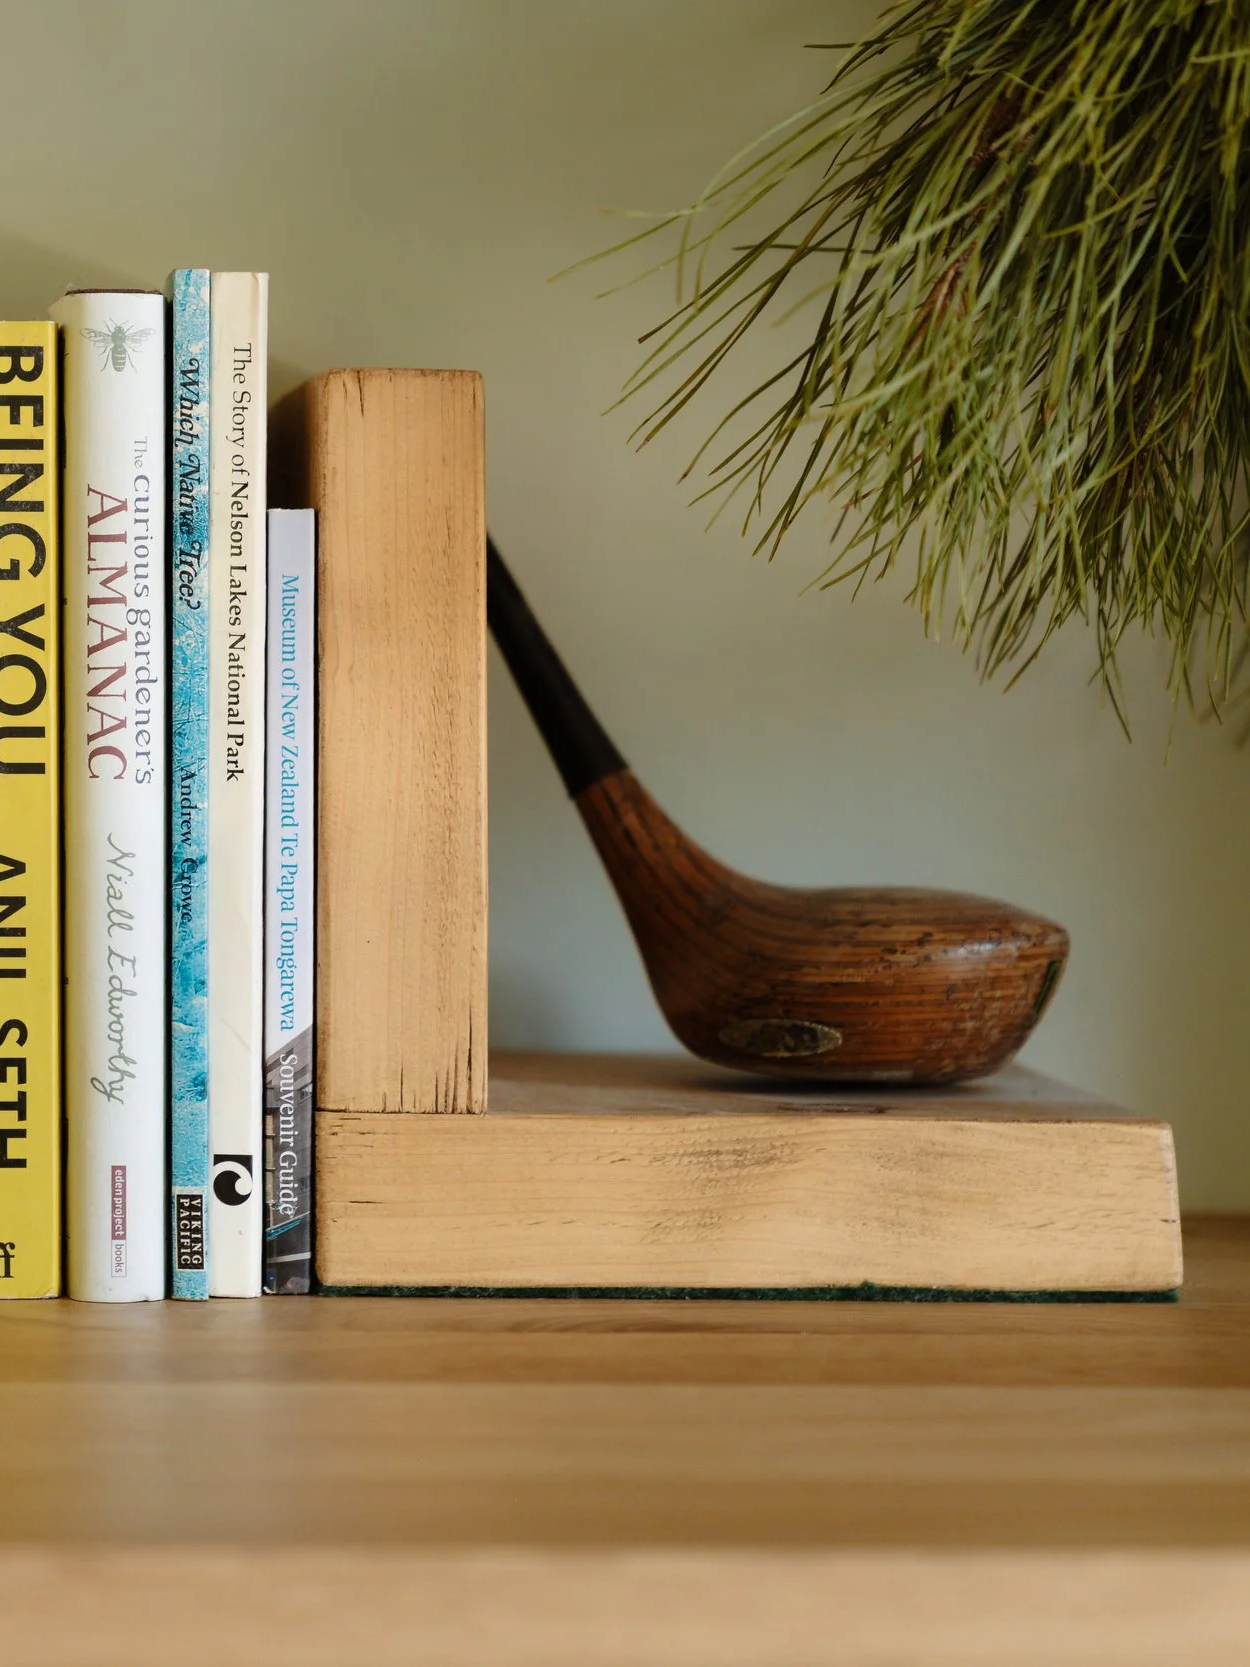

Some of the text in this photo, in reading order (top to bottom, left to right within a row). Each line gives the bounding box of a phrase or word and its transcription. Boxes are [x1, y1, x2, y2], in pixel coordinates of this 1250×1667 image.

[176, 358, 202, 610] Which Native Tree?
[225, 343, 252, 783] The Story of Nelson Lakes National Park
[87, 484, 128, 780] ALMANAC
[127, 437, 158, 785] The curious gardener's
[181, 767, 198, 848] Andrew
[277, 574, 299, 1032] Museum of New Zealand Te Papa Tongarewa
[90, 833, 138, 1103] Niall Edworthy
[114, 1170, 125, 1236] eden project
[180, 1198, 191, 1265] PACIFIC
[191, 1198, 202, 1265] VIKING
[279, 1053, 300, 1216] Souvenir Guide
[115, 1244, 124, 1273] books
